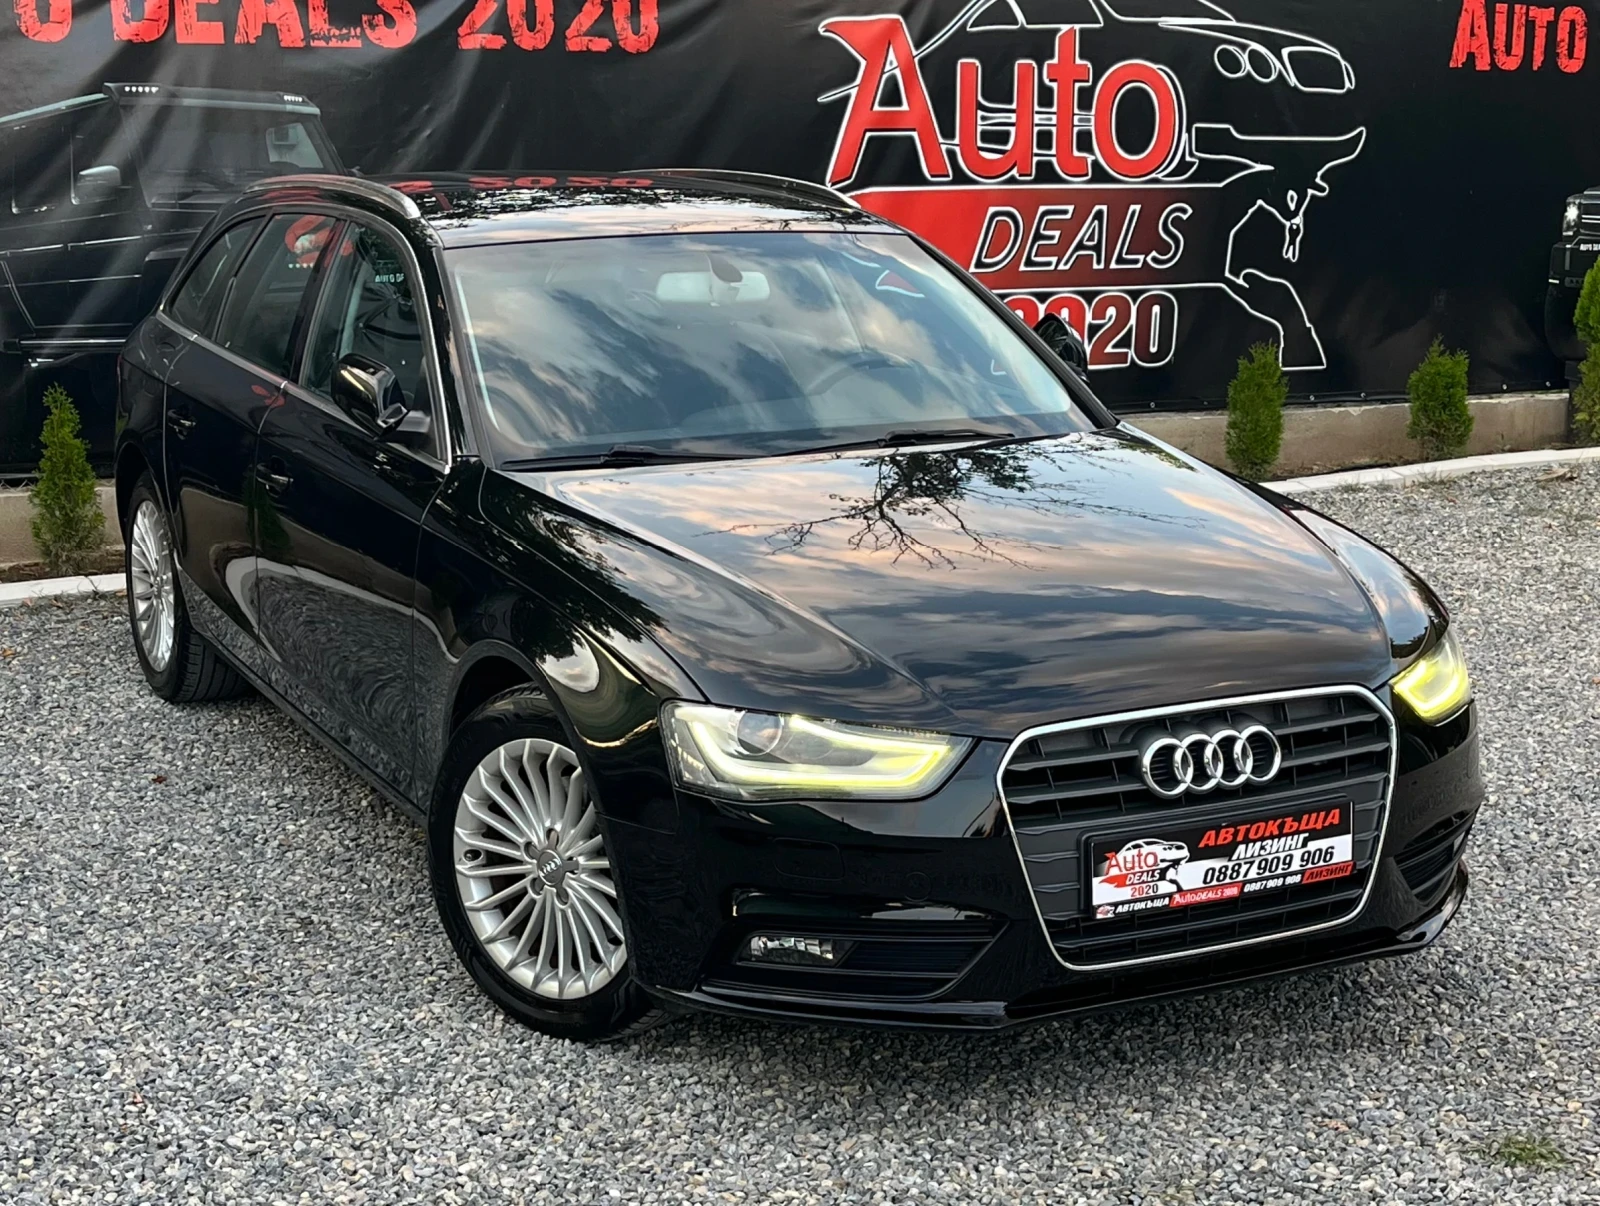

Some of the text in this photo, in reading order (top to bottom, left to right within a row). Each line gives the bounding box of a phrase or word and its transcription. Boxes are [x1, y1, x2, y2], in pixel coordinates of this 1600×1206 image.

[1449, 0, 1588, 73] AUTO
[819, 14, 1181, 184] Auto
[968, 202, 1193, 273] DEALS
[1198, 808, 1340, 848] АВТОКЪЩА
[1104, 848, 1159, 876] Auto
[1231, 833, 1309, 861] ЛИЗИНГ
[1301, 846, 1335, 868] 906
[1115, 897, 1169, 914] АВТОКЪЩА
[1305, 863, 1351, 881] ЛИЗИНГ
[1126, 870, 1160, 886] DEALS
[1130, 883, 1159, 898] 2020
